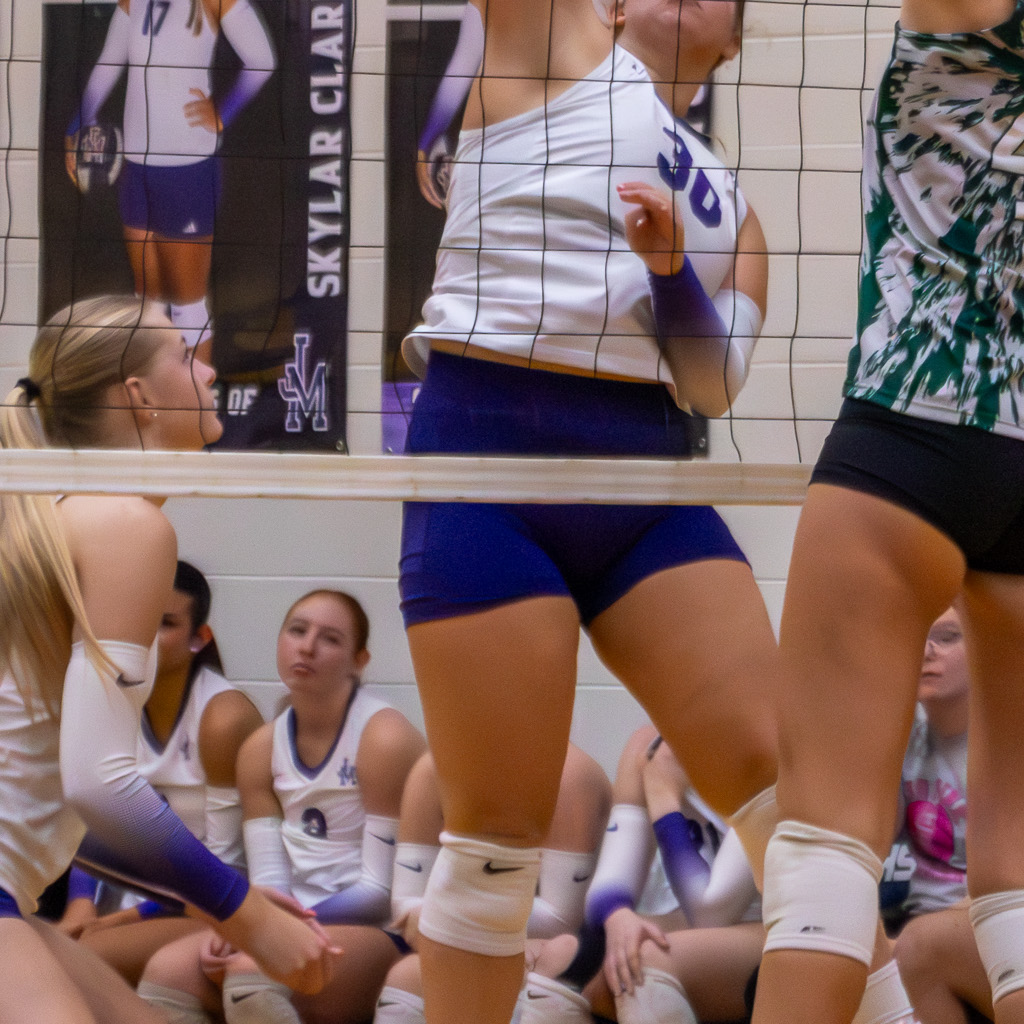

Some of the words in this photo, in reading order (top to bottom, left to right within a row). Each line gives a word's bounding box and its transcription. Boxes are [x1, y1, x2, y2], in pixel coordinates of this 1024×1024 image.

[142, 0, 171, 36] 17
[307, 128, 343, 298] SKYLAR
[227, 387, 258, 416] OF
